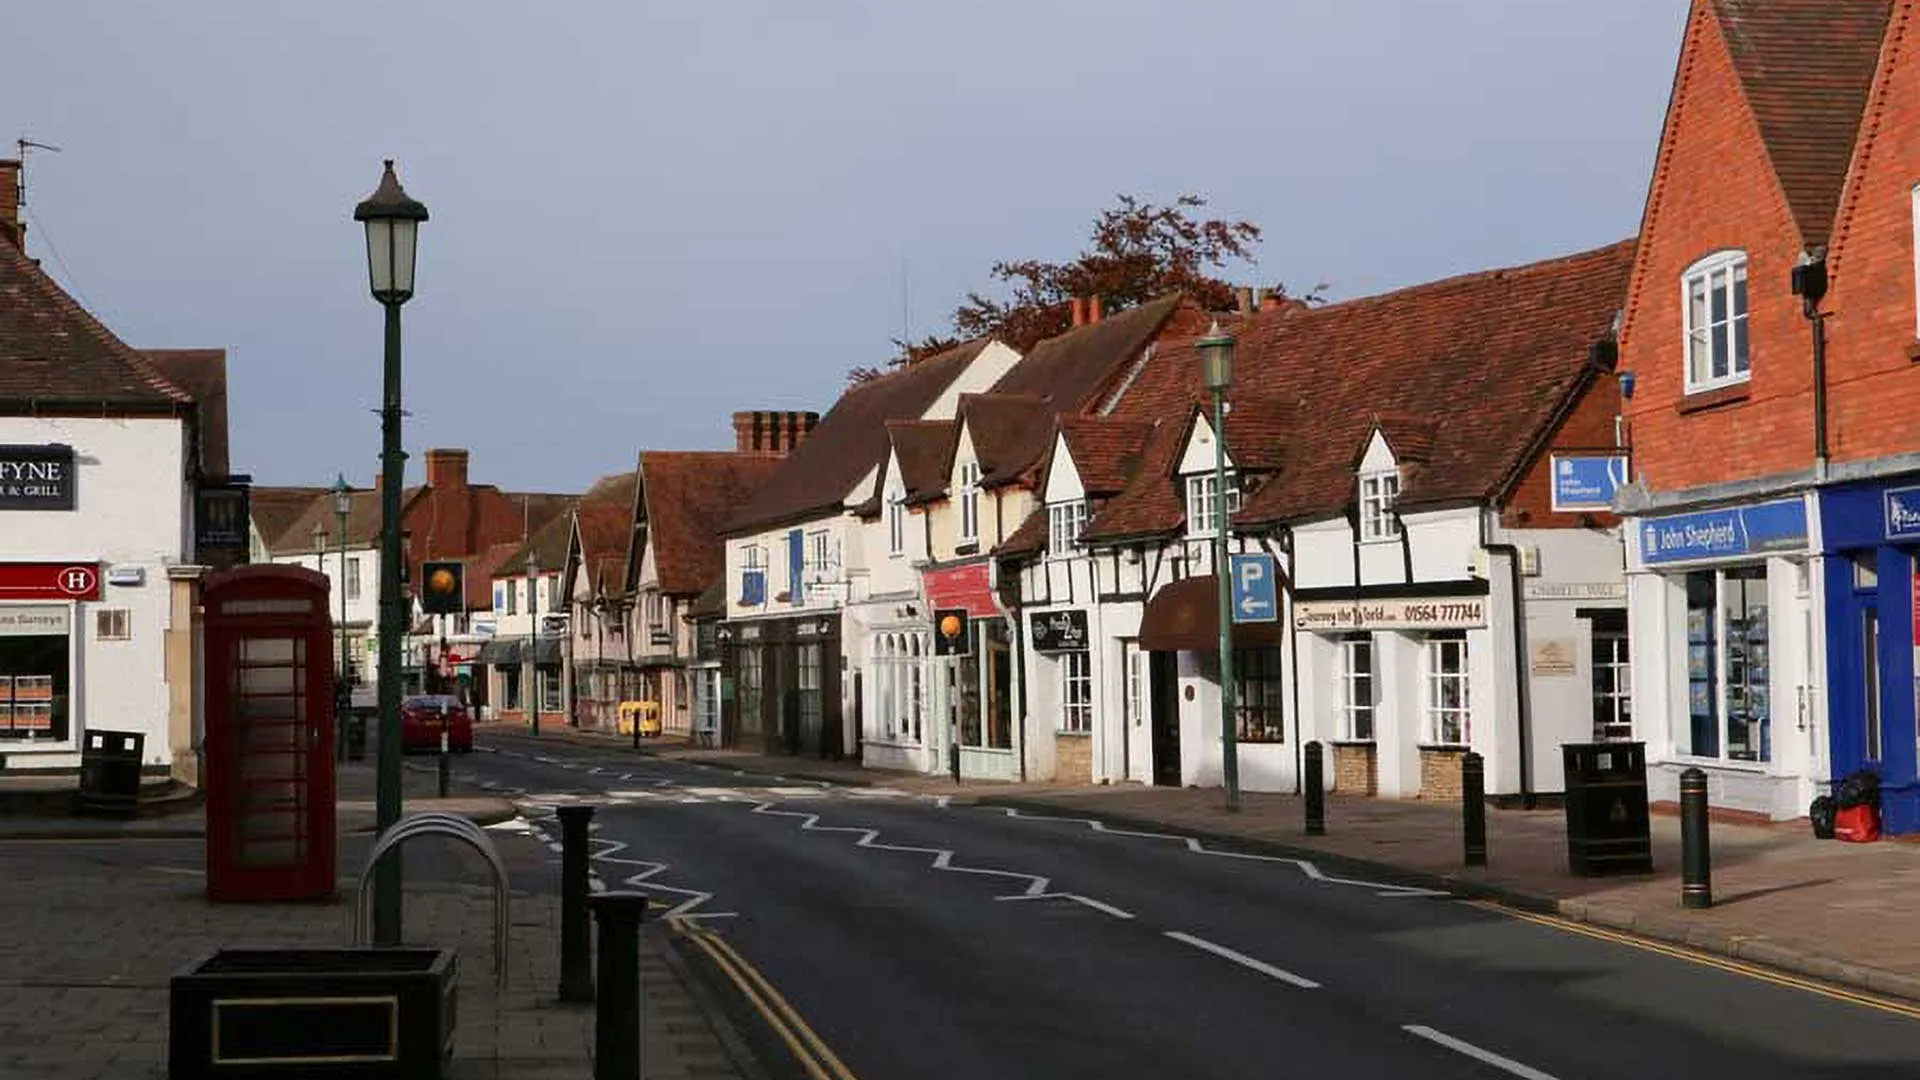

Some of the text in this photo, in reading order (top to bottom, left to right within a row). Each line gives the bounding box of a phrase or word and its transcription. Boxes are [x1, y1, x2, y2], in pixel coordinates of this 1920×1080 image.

[0, 461, 61, 480] FYNE
[24, 485, 61, 496] GRILL
[1660, 518, 1736, 551] John Shepherd
[68, 572, 85, 589] H
[1241, 562, 1264, 593] P
[1404, 604, 1438, 621] 01564
[1440, 603, 1482, 621] 777744
